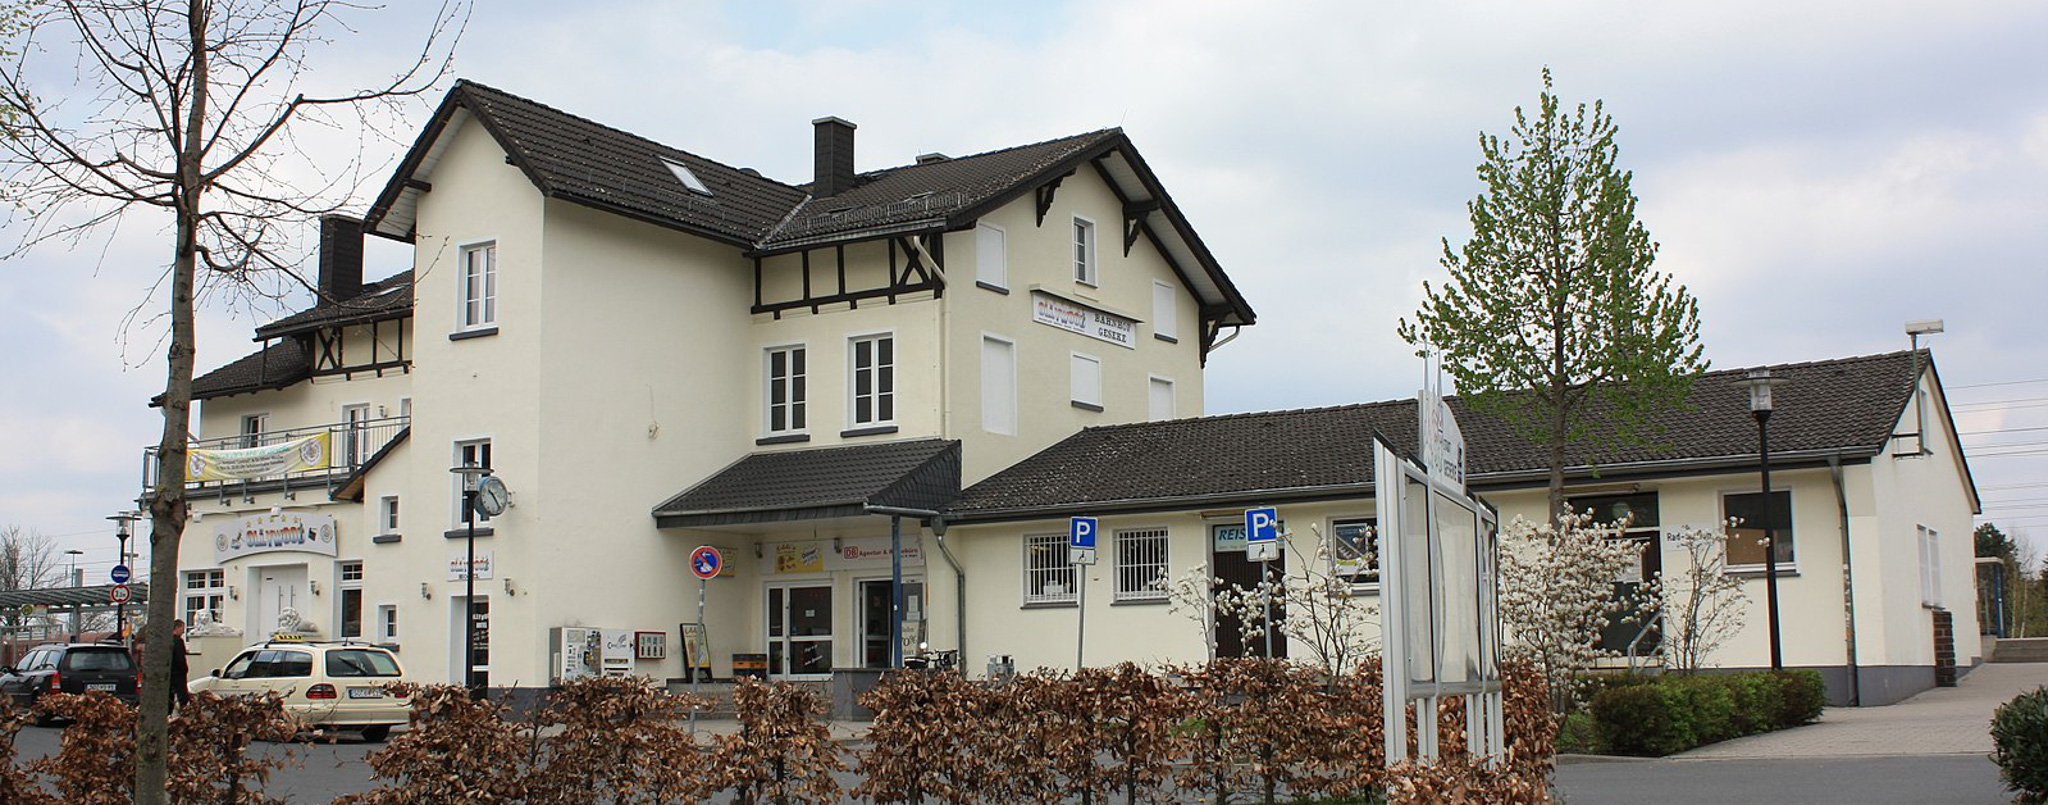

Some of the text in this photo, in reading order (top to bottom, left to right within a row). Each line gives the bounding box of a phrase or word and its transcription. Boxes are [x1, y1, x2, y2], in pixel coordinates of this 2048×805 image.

[1094, 312, 1131, 332] BAHNHOF
[1098, 326, 1127, 343] GESEKE
[1076, 521, 1091, 543] P
[1218, 528, 1246, 541] REIS
[1253, 513, 1269, 538] P
